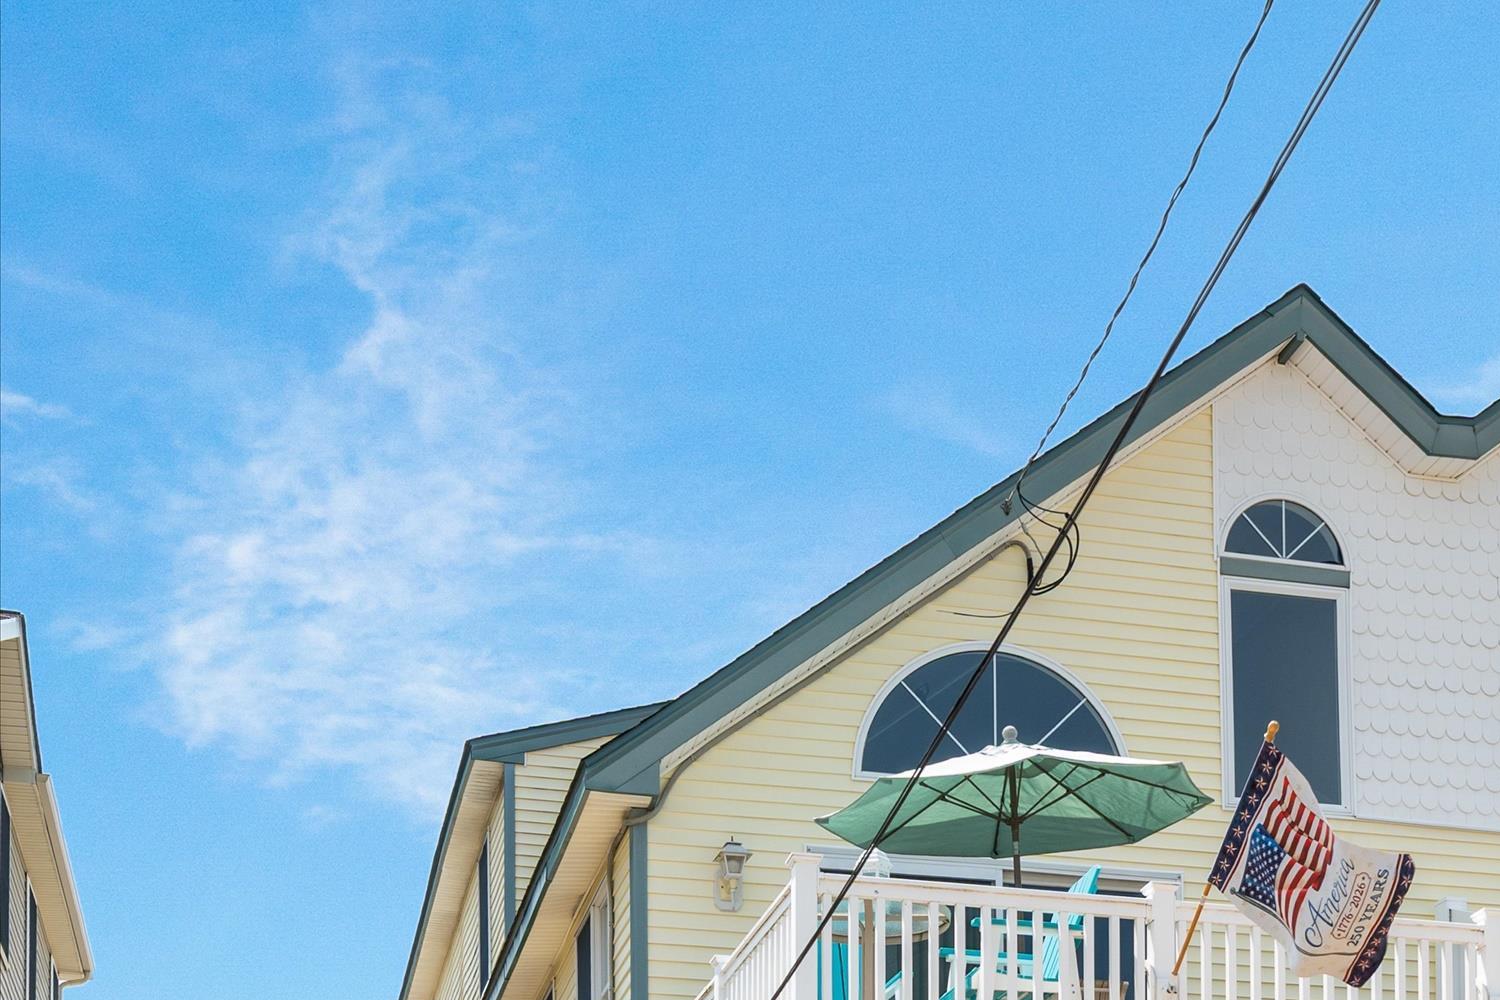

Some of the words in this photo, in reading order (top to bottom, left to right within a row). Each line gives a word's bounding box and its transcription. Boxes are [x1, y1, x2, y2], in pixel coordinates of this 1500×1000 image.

[1304, 857, 1355, 948] America
[1346, 925, 1365, 947] 250
[1358, 868, 1390, 923] YEARS
